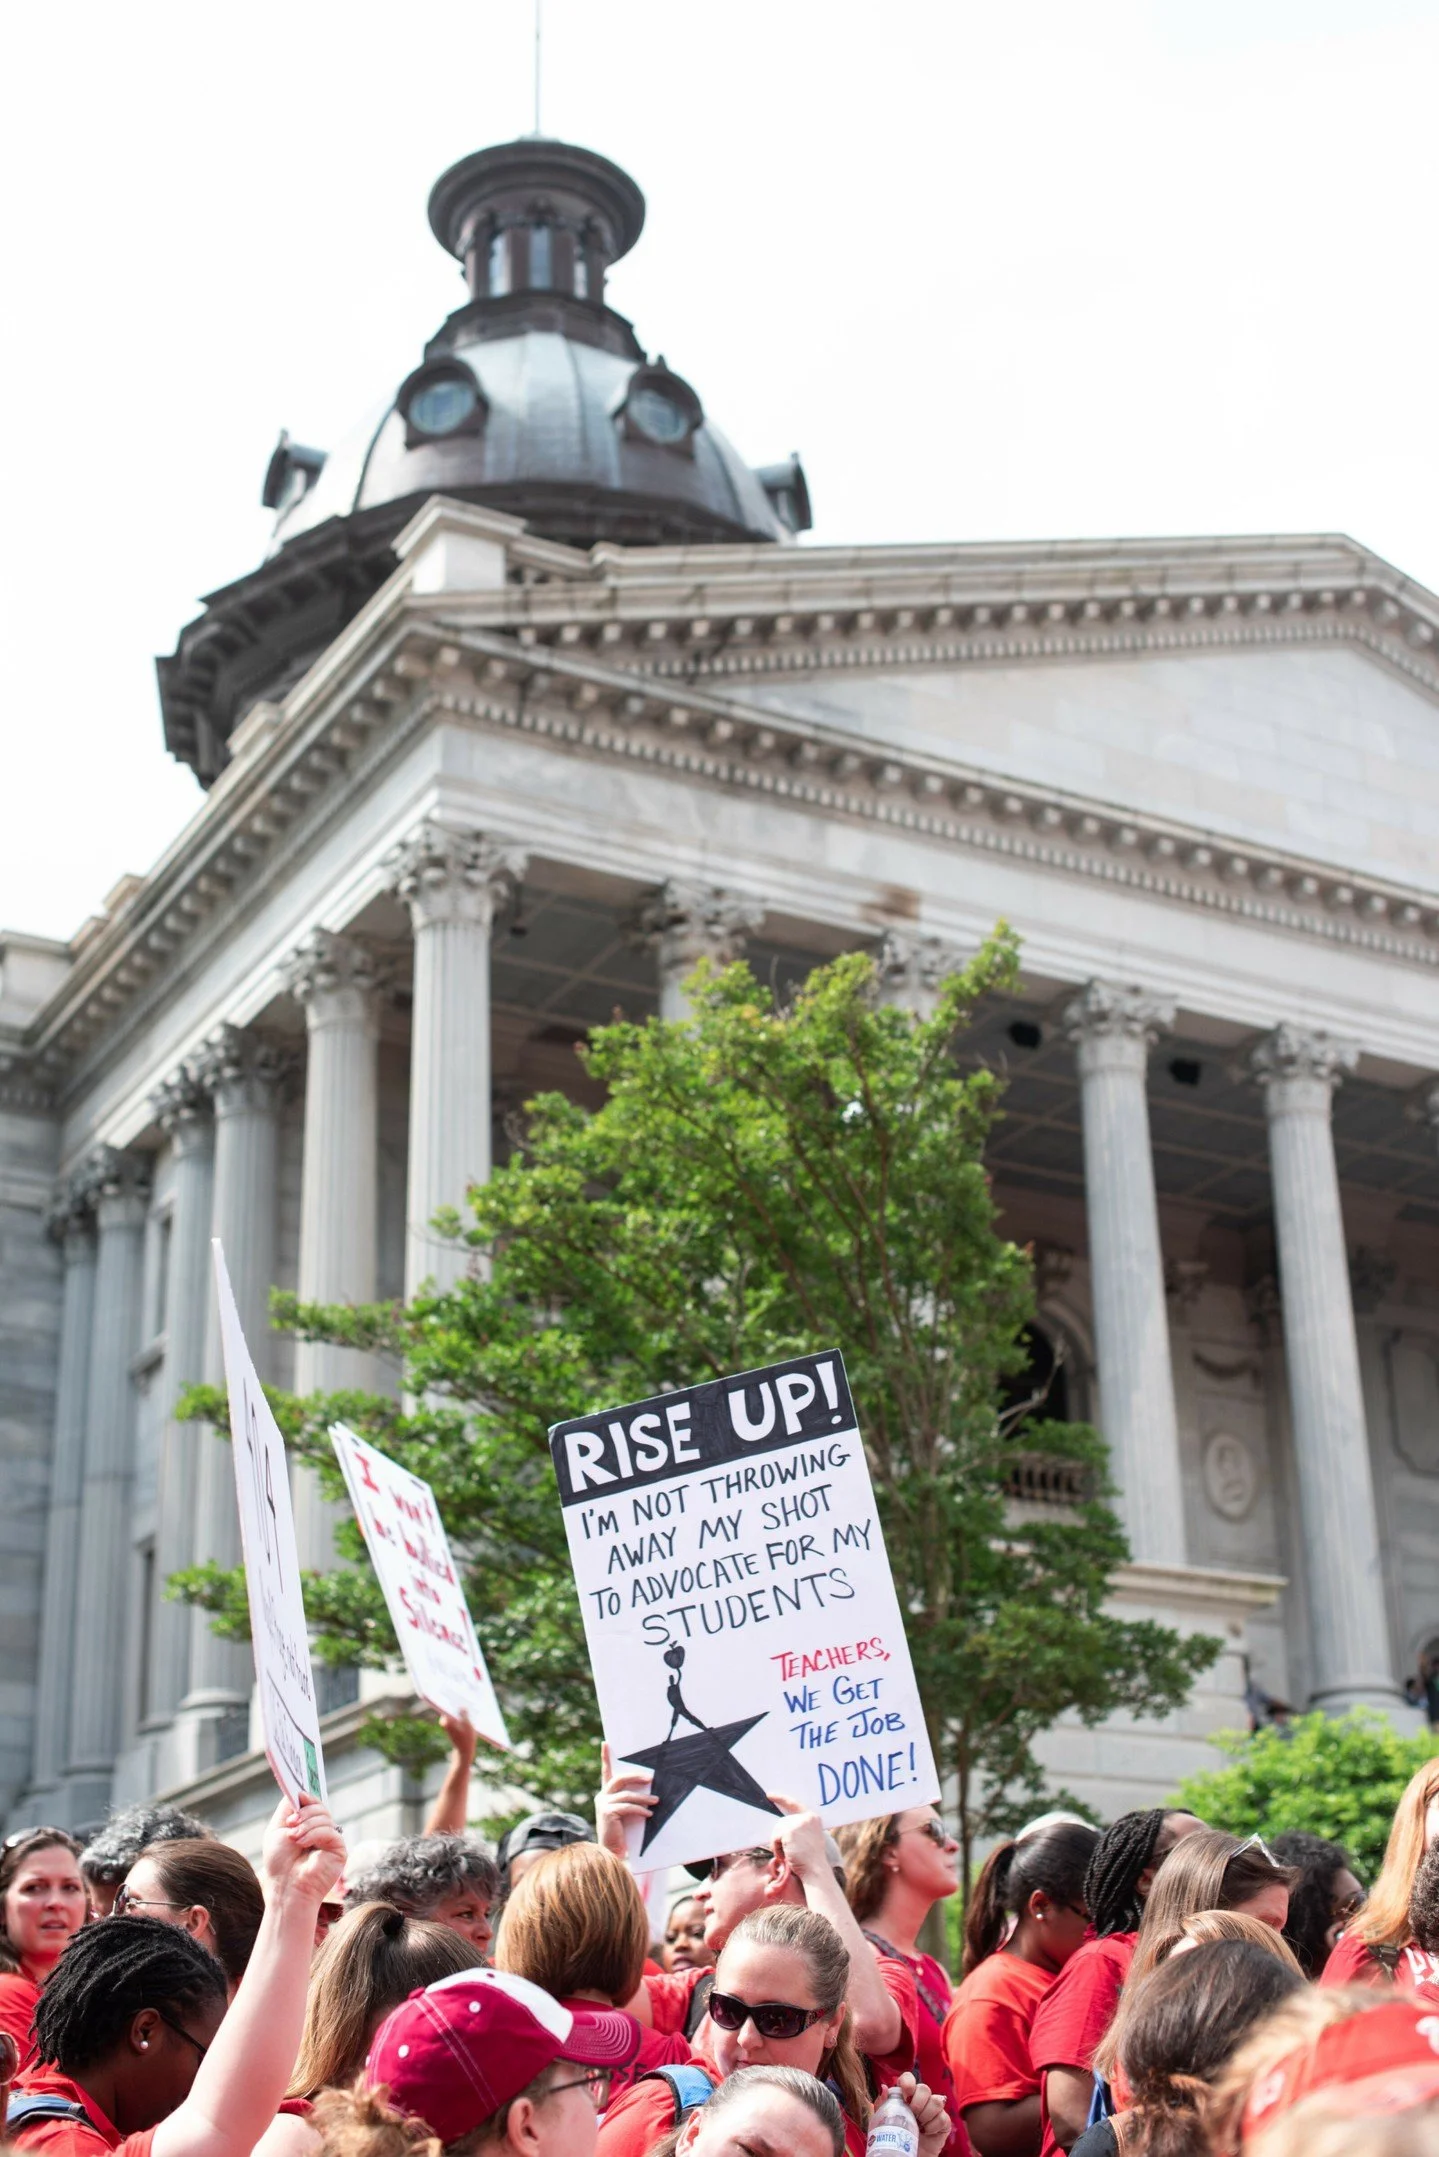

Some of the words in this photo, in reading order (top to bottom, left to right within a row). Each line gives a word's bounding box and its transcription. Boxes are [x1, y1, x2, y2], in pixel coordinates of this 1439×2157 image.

[565, 1402, 700, 1492] RISE
[729, 1361, 841, 1441] UP!
[354, 1452, 380, 1493] I
[582, 1509, 619, 1539] I'M
[633, 1485, 689, 1526] NOT
[700, 1444, 851, 1503] THROWING
[608, 1527, 676, 1574] AWAY
[699, 1510, 742, 1549] MY
[762, 1484, 832, 1530] SHOT
[589, 1587, 620, 1619] TO
[632, 1553, 759, 1608] ADVOCATE
[766, 1535, 825, 1570] FOR
[833, 1519, 871, 1553] MY
[642, 1568, 855, 1645] STUDENTS
[770, 1637, 890, 1681] TEACHERS,
[783, 1686, 820, 1713] WE
[833, 1676, 883, 1704] GET
[790, 1721, 839, 1749] THE
[847, 1707, 905, 1738] JOB
[818, 1742, 917, 1806] DONE!
[876, 2133, 897, 2143] WATER
